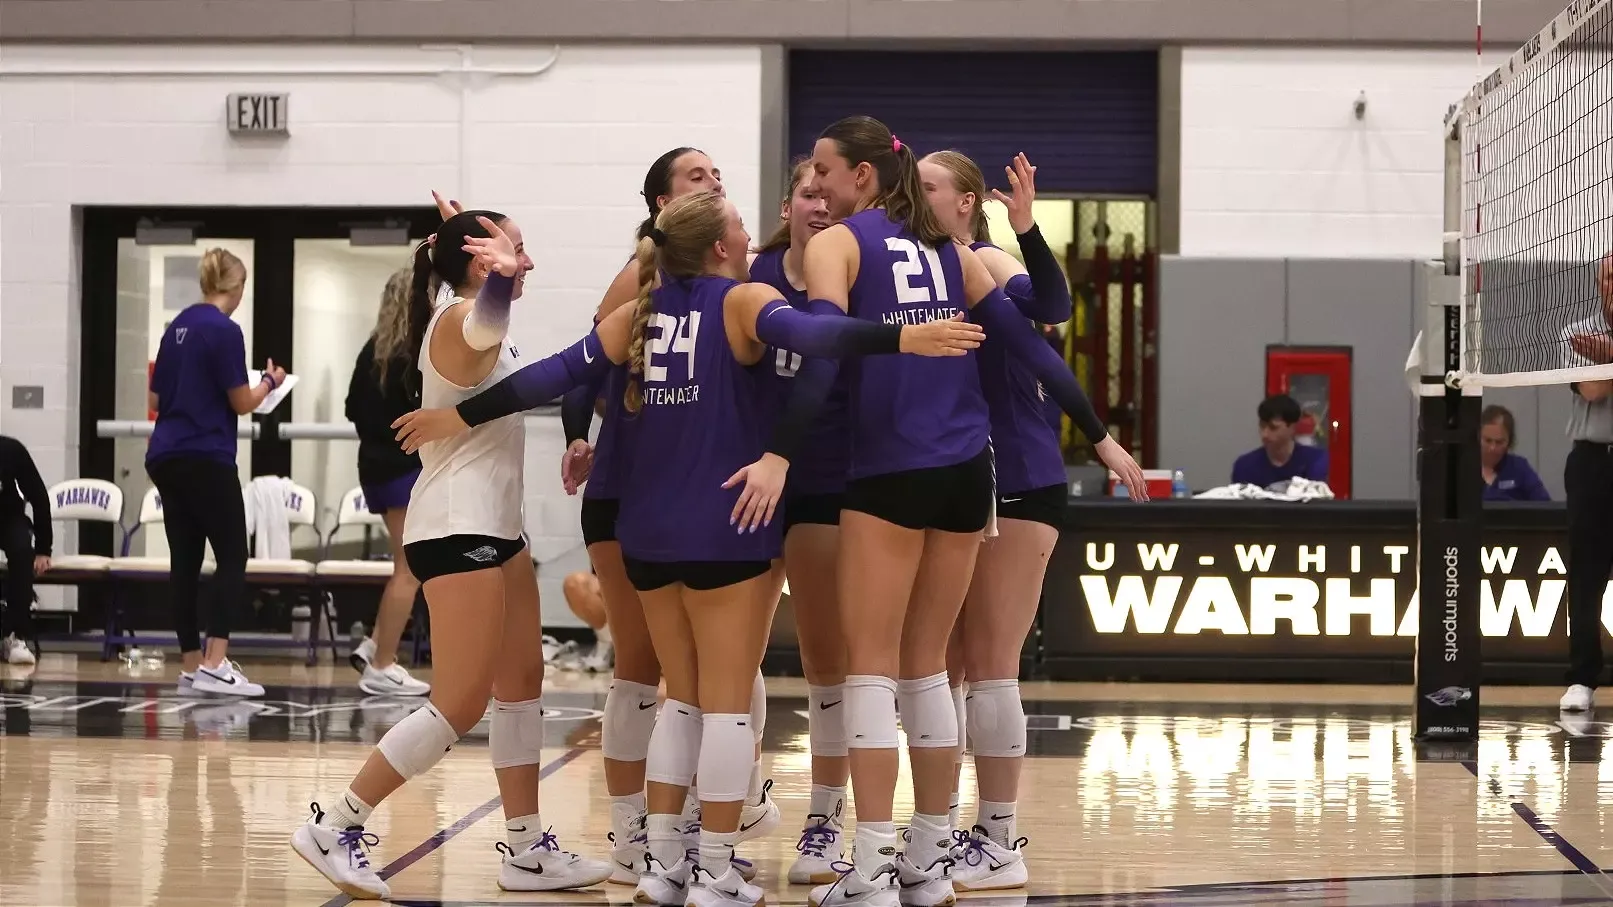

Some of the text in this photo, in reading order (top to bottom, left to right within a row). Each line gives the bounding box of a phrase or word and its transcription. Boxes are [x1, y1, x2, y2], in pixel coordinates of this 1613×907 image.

[238, 96, 280, 129] EXIT
[884, 237, 948, 304] 21
[882, 308, 960, 325] WHITEWATE
[644, 310, 701, 382] 24
[56, 487, 111, 510] WARHAWKS
[1442, 546, 1459, 662] sports imports
